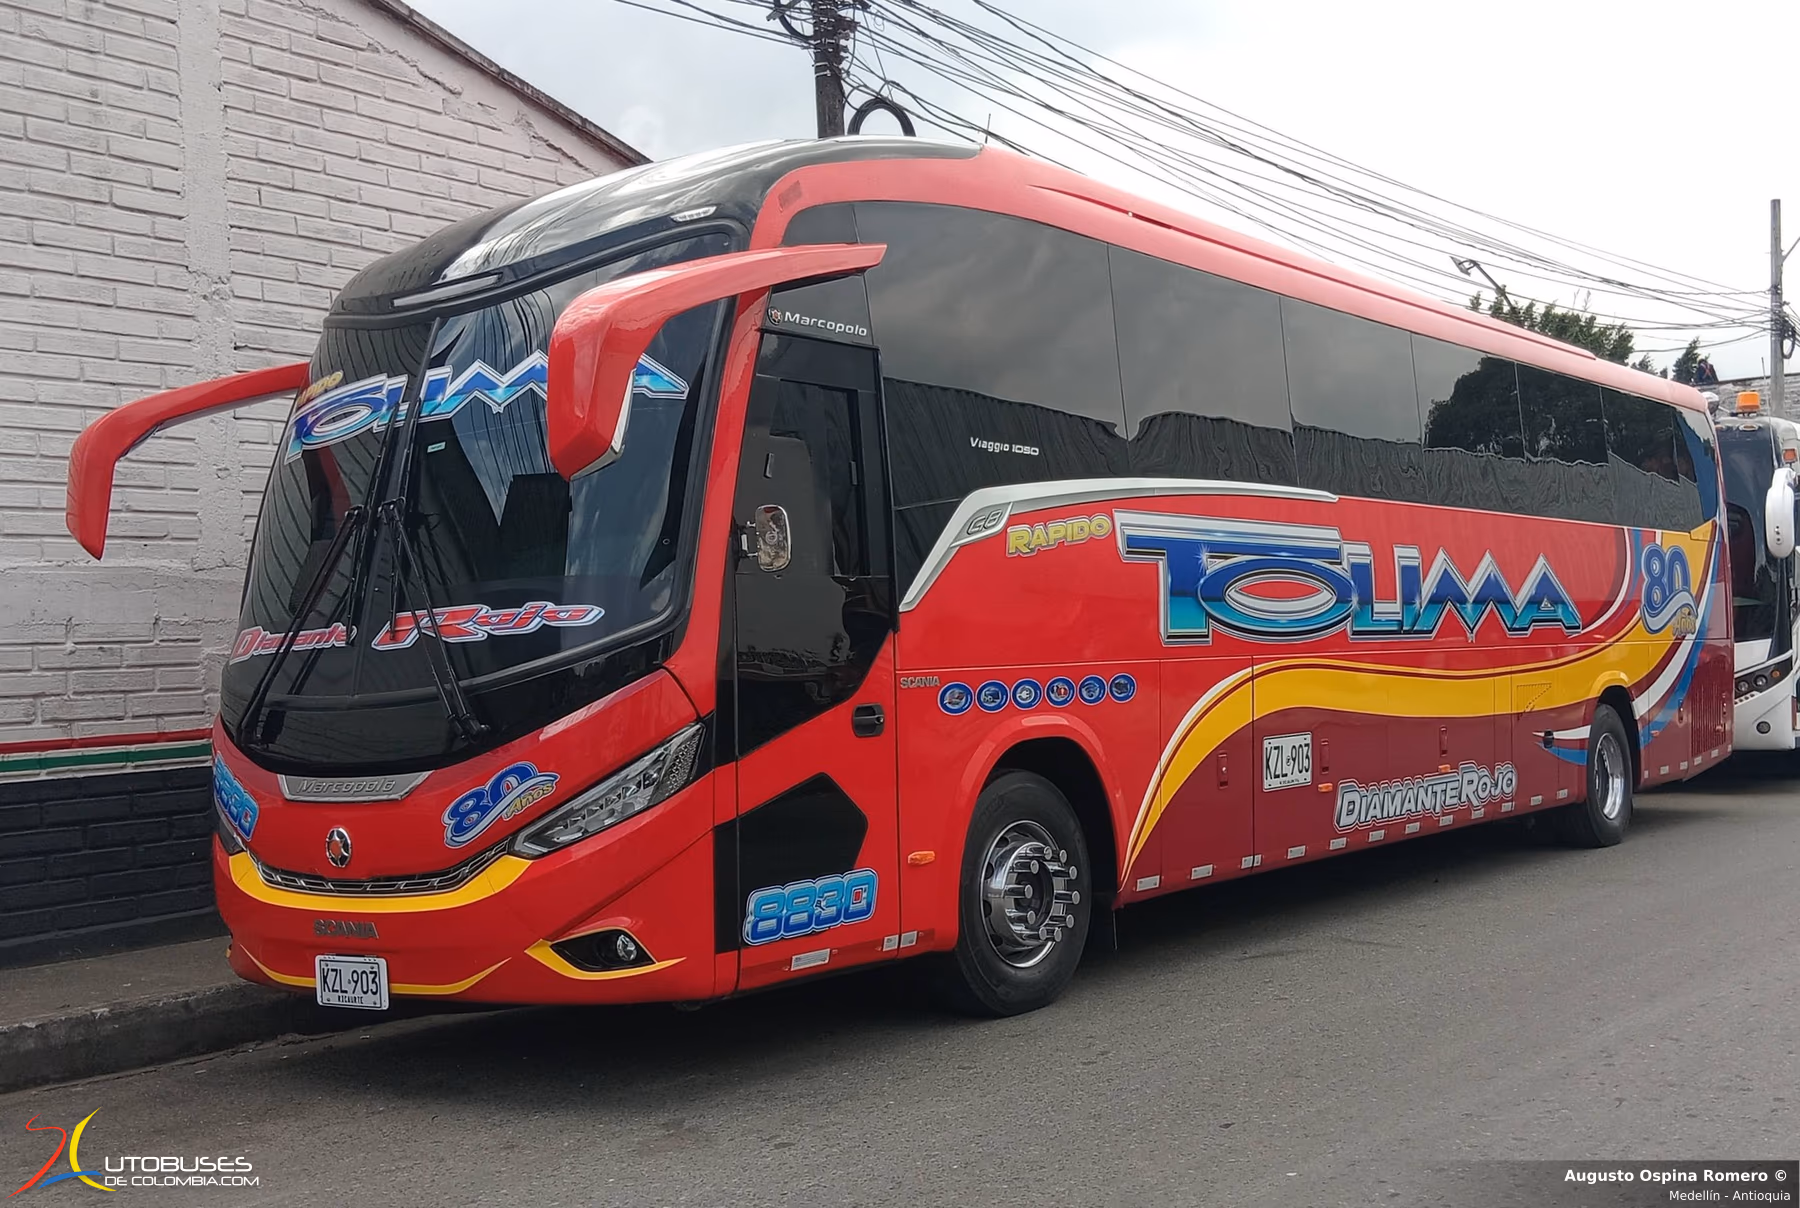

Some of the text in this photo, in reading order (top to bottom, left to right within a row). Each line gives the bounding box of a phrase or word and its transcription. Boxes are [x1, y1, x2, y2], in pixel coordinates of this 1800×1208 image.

[784, 311, 867, 336] Marcopolo
[970, 436, 1039, 456] Viaggio 1050
[966, 509, 1003, 536] G8
[1006, 513, 1113, 558] RAPIDO
[1112, 509, 1582, 647] TOLIMA
[1641, 543, 1692, 622] 80
[371, 601, 606, 651] Rojo
[900, 676, 940, 689] SCANIA
[296, 778, 396, 796] Marcopolo
[441, 761, 540, 847] 80
[743, 868, 879, 945] 8830
[313, 918, 380, 939] SCANIA
